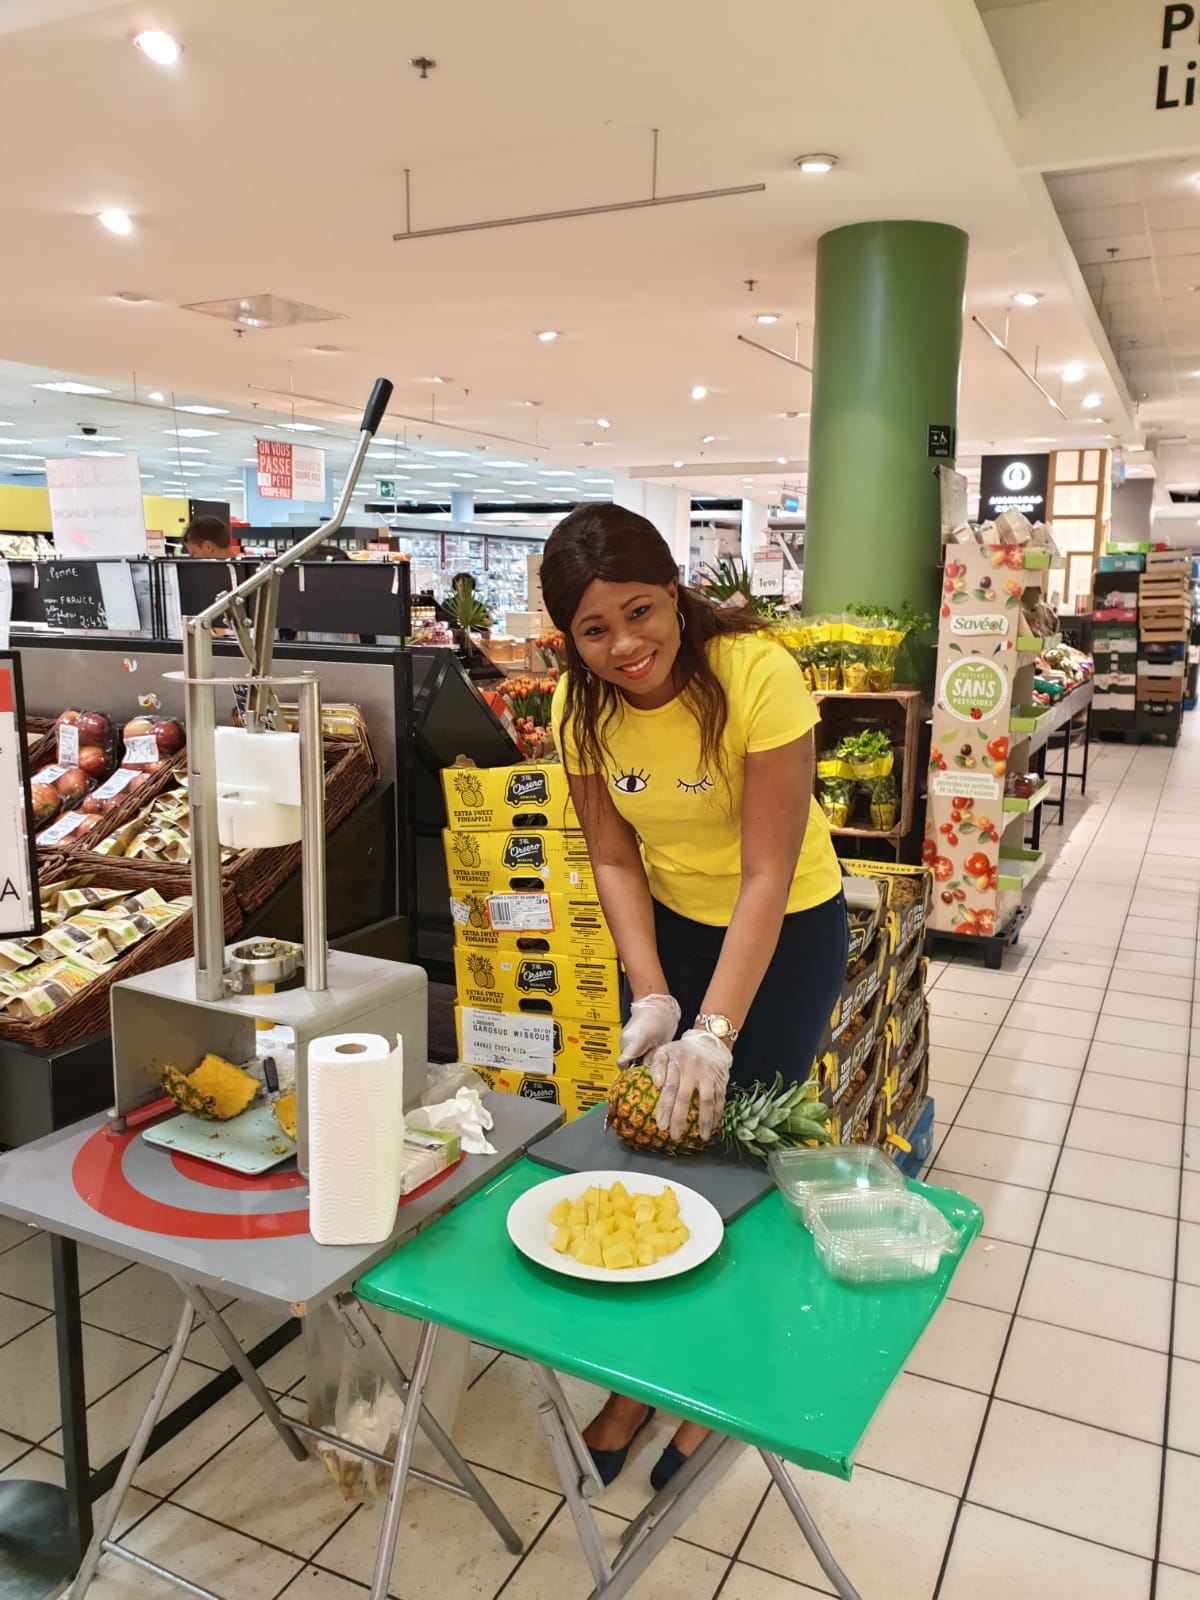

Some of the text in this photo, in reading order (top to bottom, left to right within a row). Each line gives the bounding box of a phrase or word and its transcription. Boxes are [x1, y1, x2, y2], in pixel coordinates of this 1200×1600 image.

[1162, 3, 1200, 49] P
[259, 441, 291, 457] ON VOUS
[260, 455, 291, 475] PASSE
[272, 475, 291, 487] PETIT
[60, 595, 95, 605] FRANCE
[953, 617, 1005, 631] Savéol
[951, 678, 996, 698] SANS
[952, 697, 993, 707] PESTICIDES
[512, 780, 543, 795] Orsero
[510, 843, 540, 857] Orsero
[465, 936, 499, 944] PINEAPPLES
[523, 970, 552, 982] Orsero
[466, 989, 483, 997] EXTRA
[469, 996, 503, 1004] PINEAPPLES
[473, 1024, 508, 1036] GAROSUD
[513, 1030, 550, 1041] WISSOUS
[494, 1044, 510, 1052] COSTA
